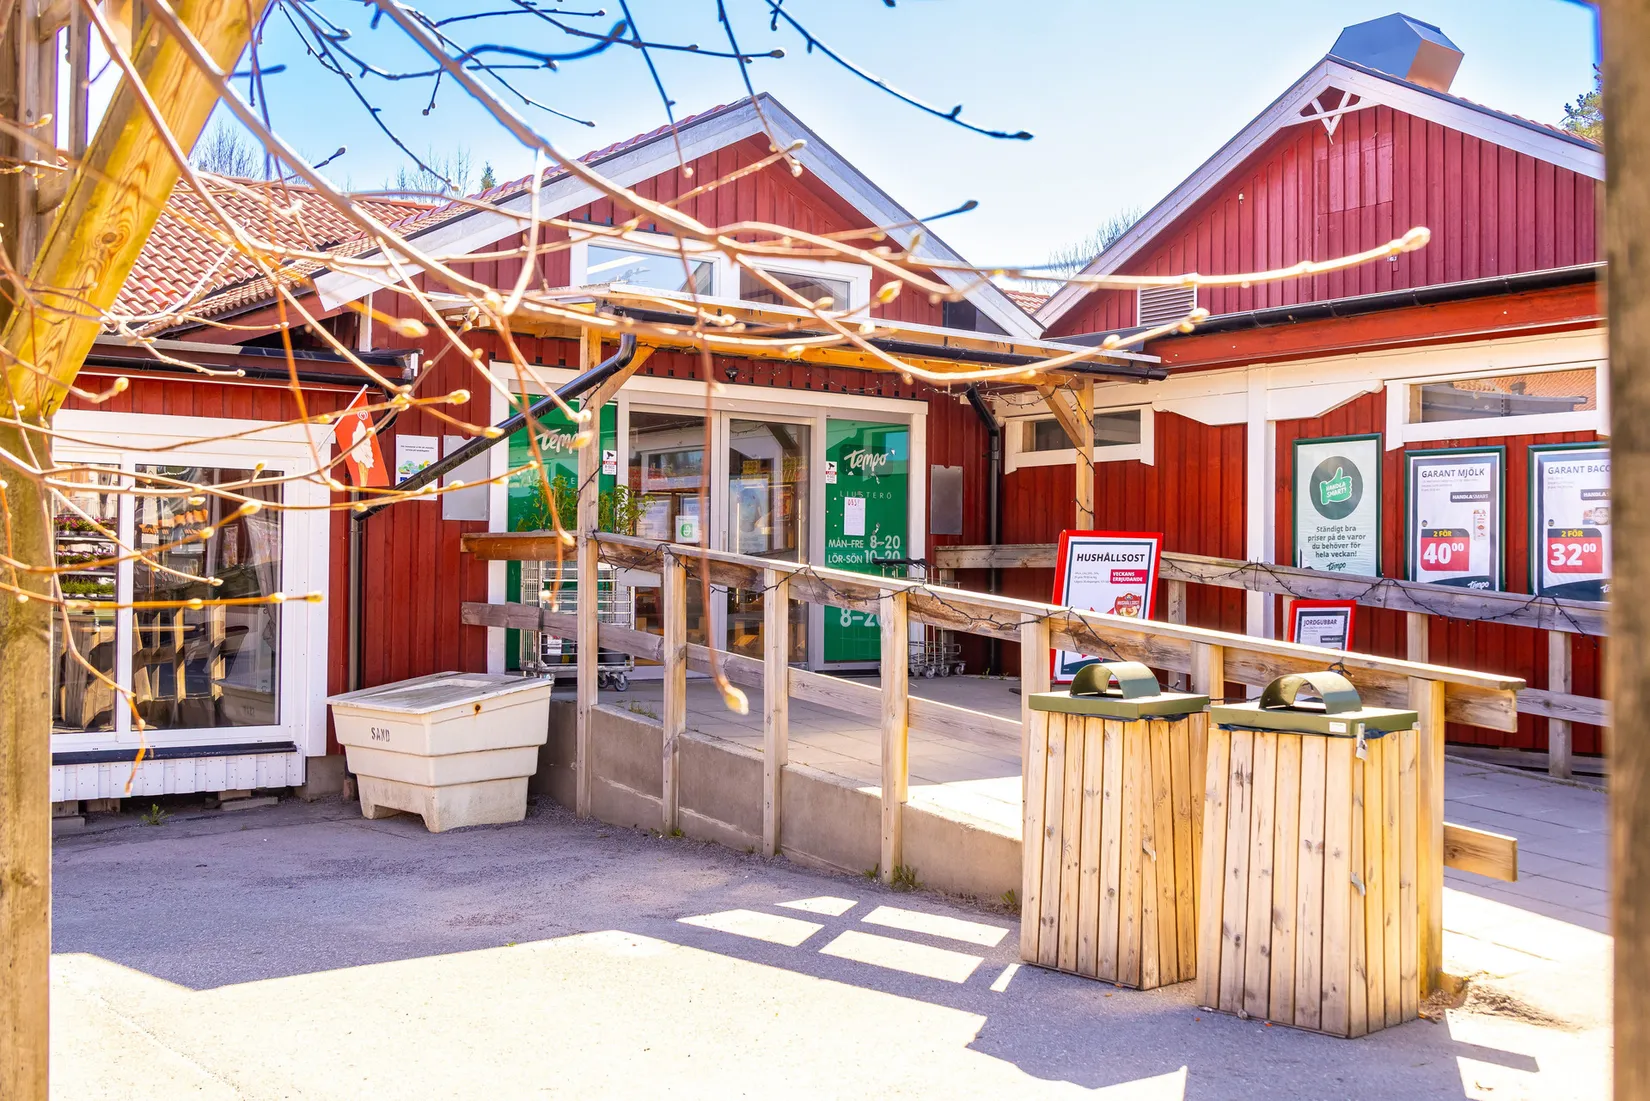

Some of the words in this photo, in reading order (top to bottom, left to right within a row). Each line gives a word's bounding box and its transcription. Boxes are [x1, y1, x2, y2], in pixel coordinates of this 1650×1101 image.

[1421, 470, 1455, 478] GARANT
[1457, 468, 1485, 478] MJÖLK
[1547, 466, 1585, 475] GARANT
[1316, 525, 1343, 534] Ständigt
[1345, 524, 1357, 532] bra
[1439, 529, 1452, 537] FÖR
[1568, 529, 1584, 537] FÖR
[1308, 533, 1326, 542] priser
[1327, 532, 1336, 542] på
[1338, 533, 1346, 541] de
[1347, 532, 1366, 540] varor
[1322, 542, 1349, 551] behöver
[828, 552, 863, 564] LÖR-SÖN
[1076, 552, 1145, 562] HUSHÅLLSOST
[1315, 550, 1330, 558] hela
[370, 726, 390, 742] SAND
